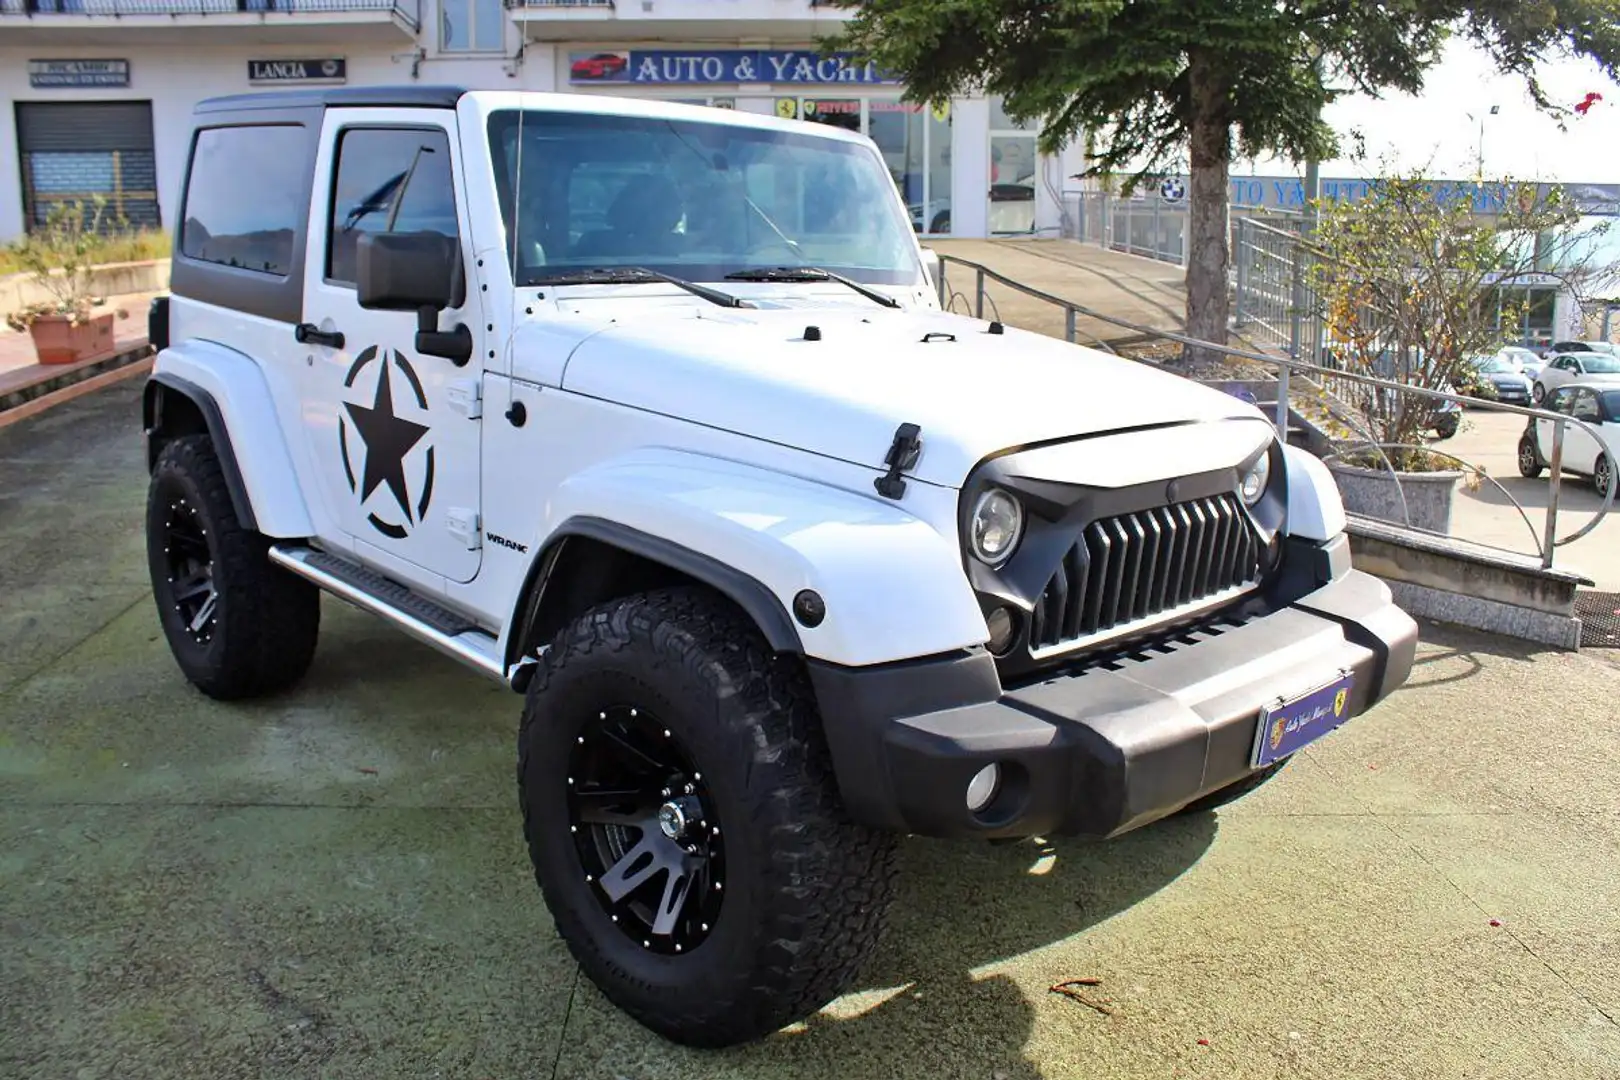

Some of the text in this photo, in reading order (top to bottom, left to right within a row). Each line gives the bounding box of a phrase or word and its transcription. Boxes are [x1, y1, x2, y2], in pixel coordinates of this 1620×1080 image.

[253, 62, 307, 78] LANCIA
[636, 56, 723, 80] AUTO
[734, 56, 756, 80] &
